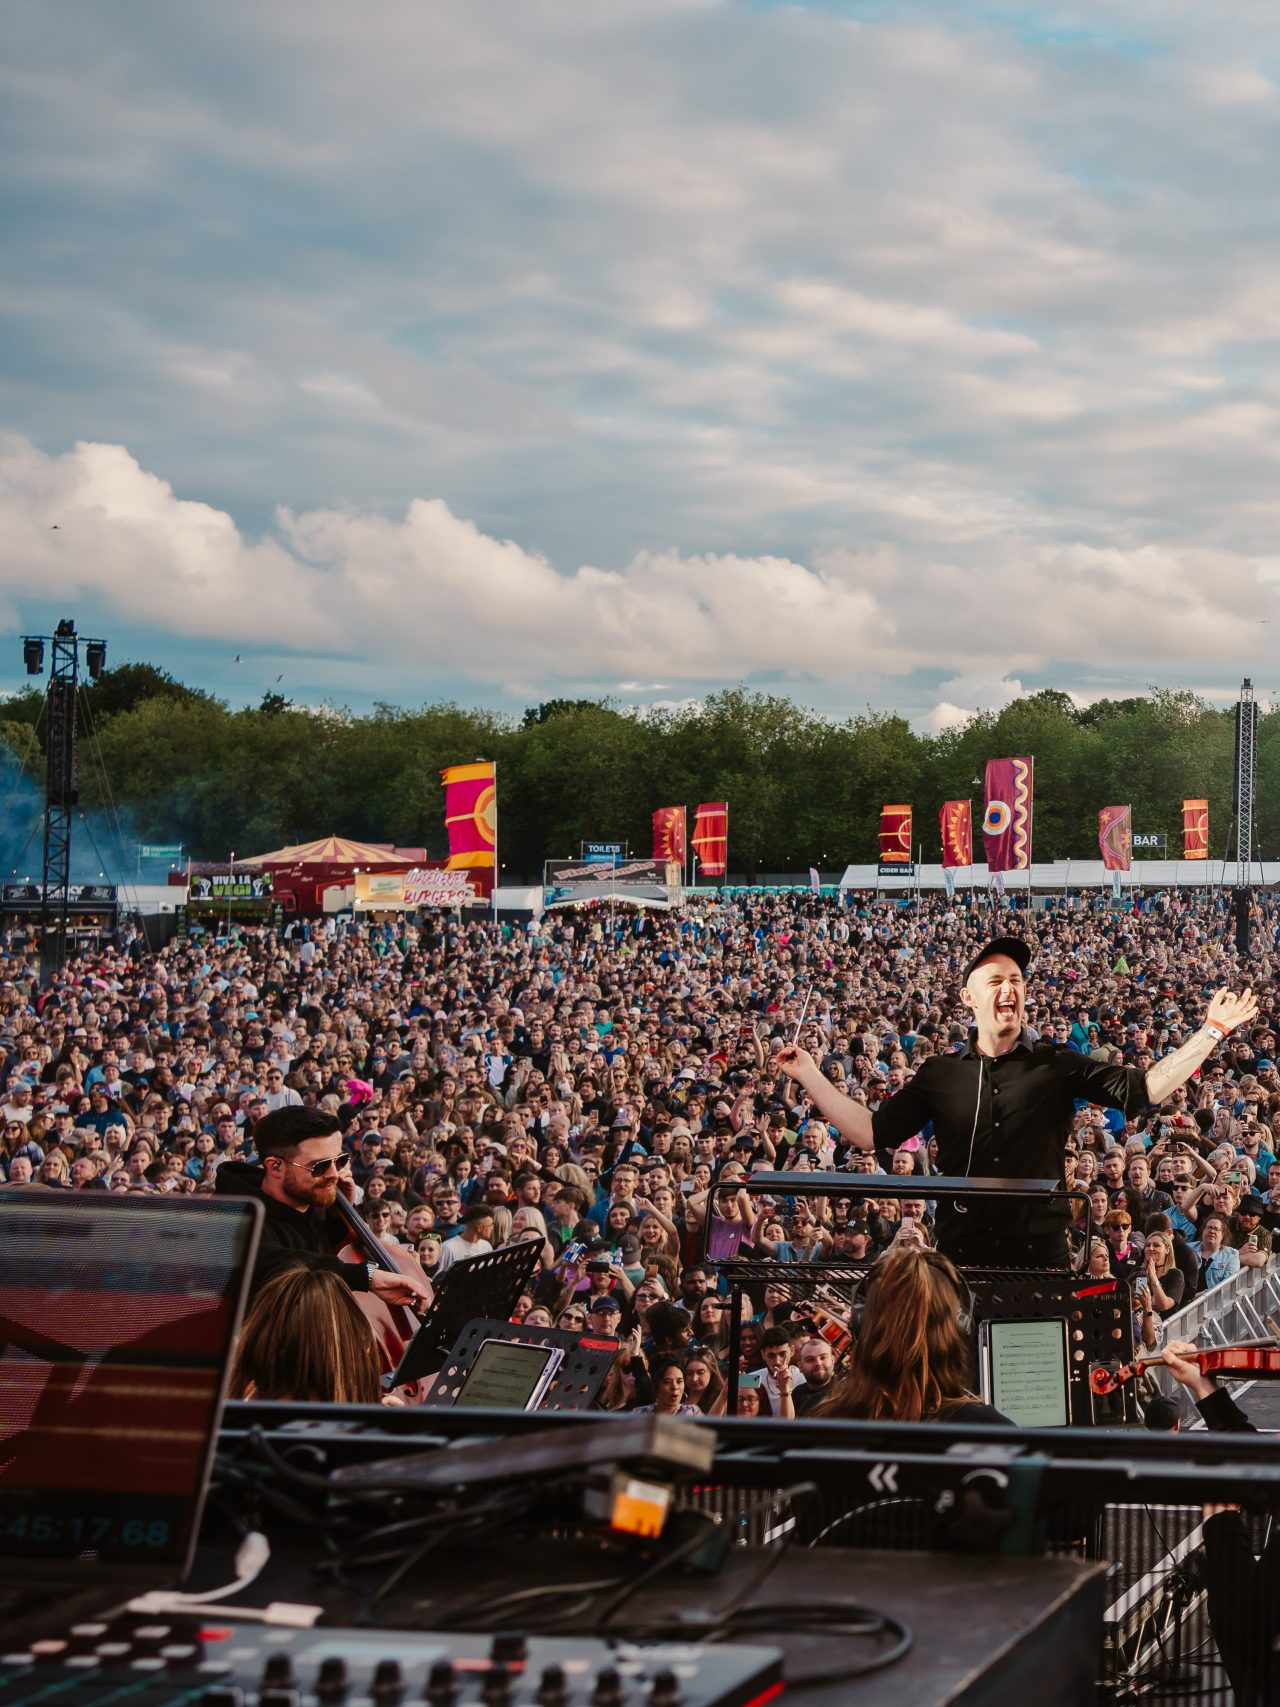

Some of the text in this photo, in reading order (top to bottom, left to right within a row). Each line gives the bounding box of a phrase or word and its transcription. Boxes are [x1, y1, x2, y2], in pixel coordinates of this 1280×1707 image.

[1133, 835, 1158, 846] BAR
[588, 845, 620, 853] TOILETS
[212, 875, 251, 885] VIVA LA
[212, 884, 252, 896] VEGI
[403, 889, 466, 905] BURGERS
